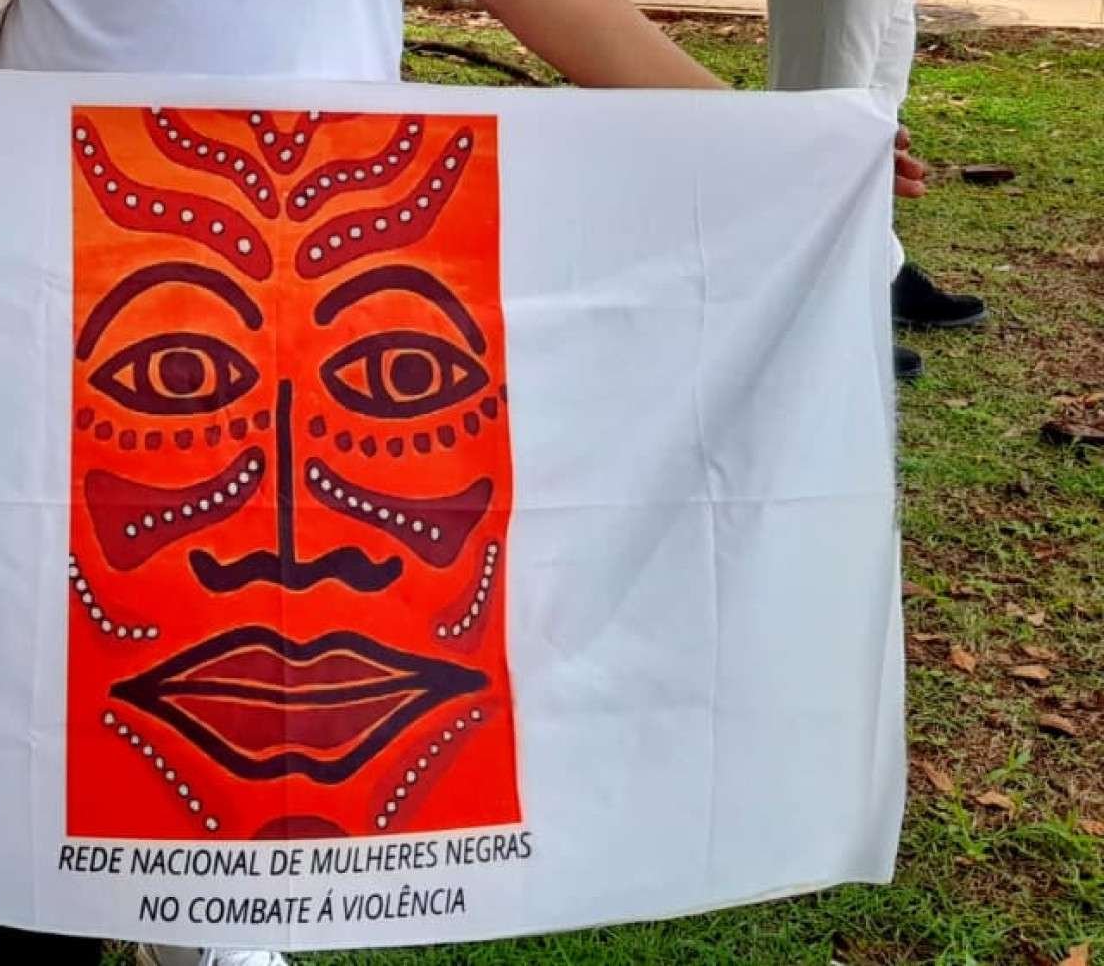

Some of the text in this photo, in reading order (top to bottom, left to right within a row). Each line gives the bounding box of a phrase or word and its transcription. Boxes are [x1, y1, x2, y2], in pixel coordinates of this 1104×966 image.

[58, 831, 532, 877] REDE NACIONAL DE MULHERES NEGRAS
[139, 884, 466, 925] NO COMBATE Á VIOLÊNCIA
